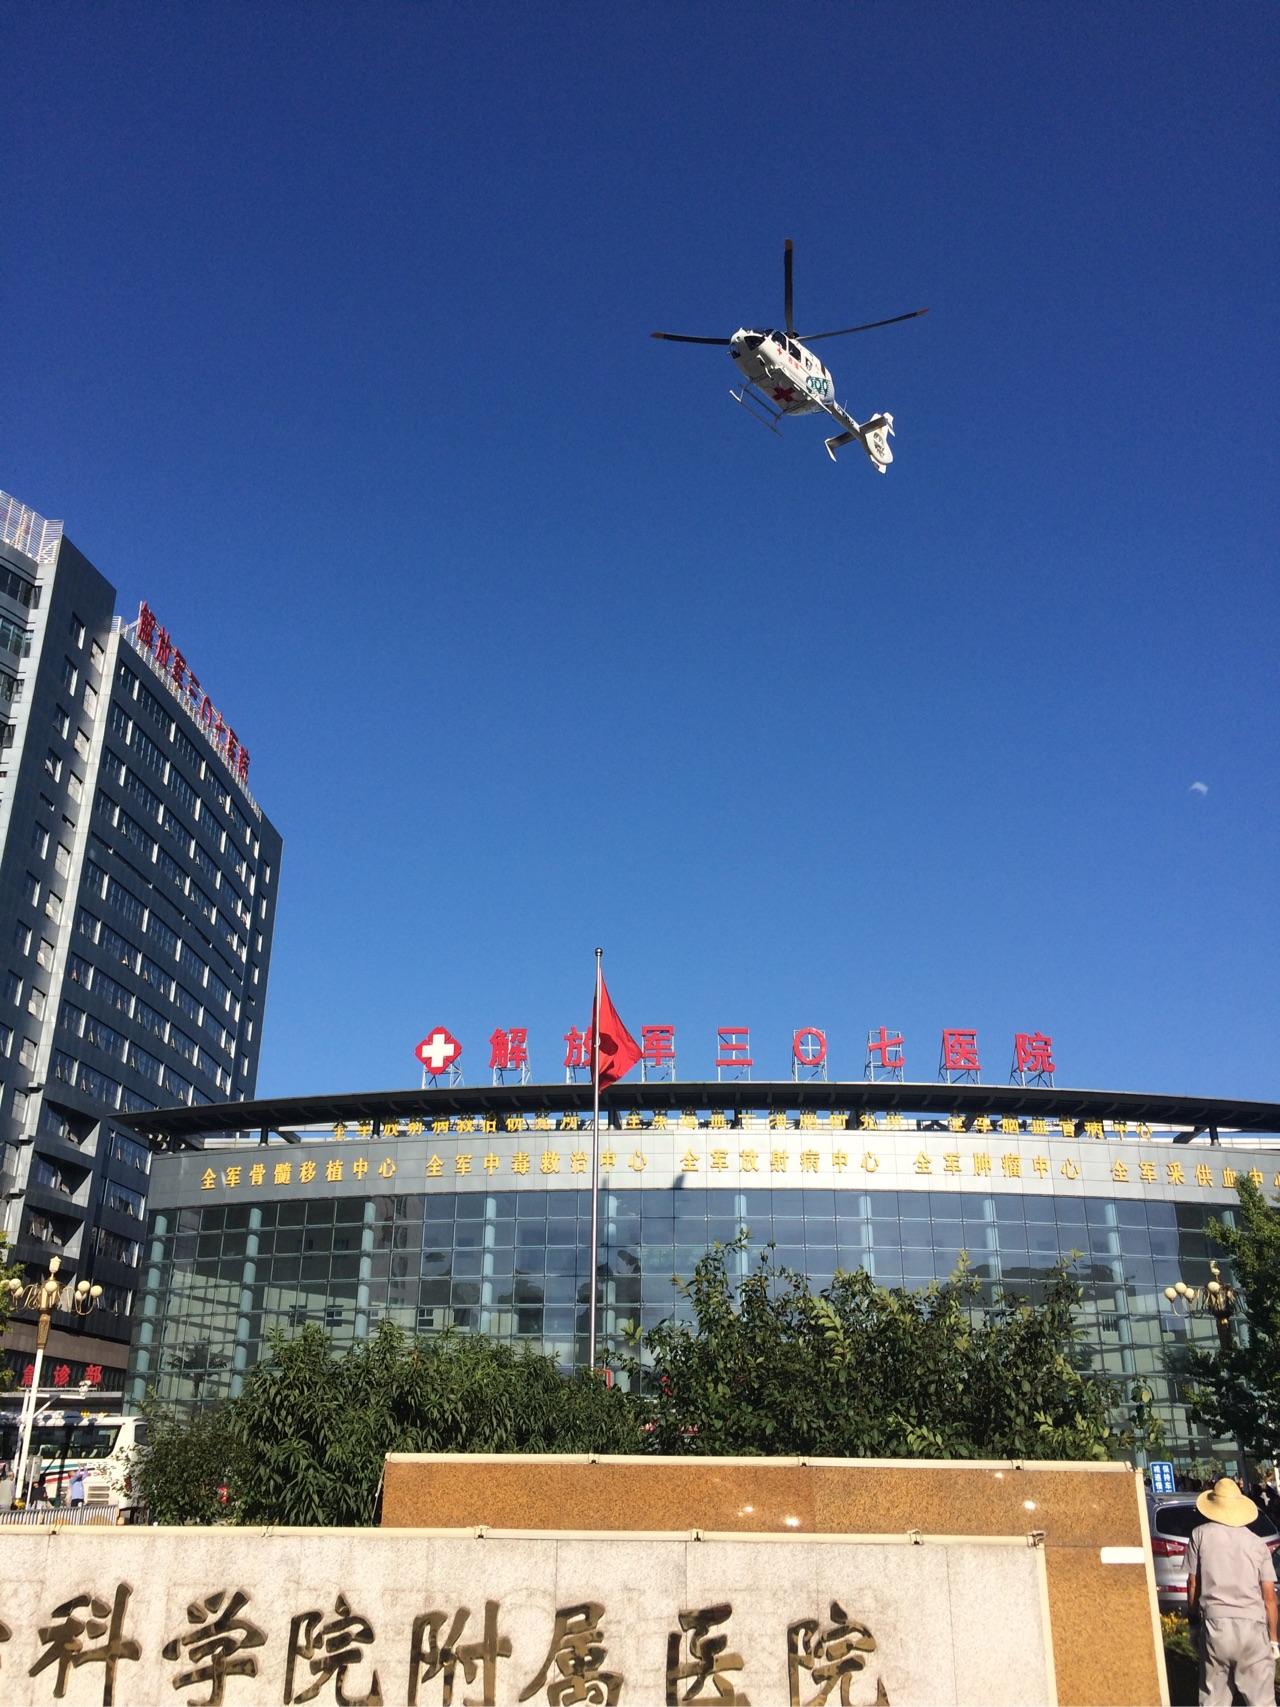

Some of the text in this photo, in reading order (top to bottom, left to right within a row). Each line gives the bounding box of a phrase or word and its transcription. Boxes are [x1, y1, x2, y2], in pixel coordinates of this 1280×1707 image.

[200, 1155, 397, 1190] 全军骨髓移植中心
[425, 1150, 649, 1178] 全军中毒救治中心
[680, 1148, 880, 1174] 全军放射病中心
[914, 1150, 1080, 1181] 全军肿瘤中心
[21, 1363, 103, 1387] 急诊部
[0, 1583, 891, 1707] 科学院附属医院
